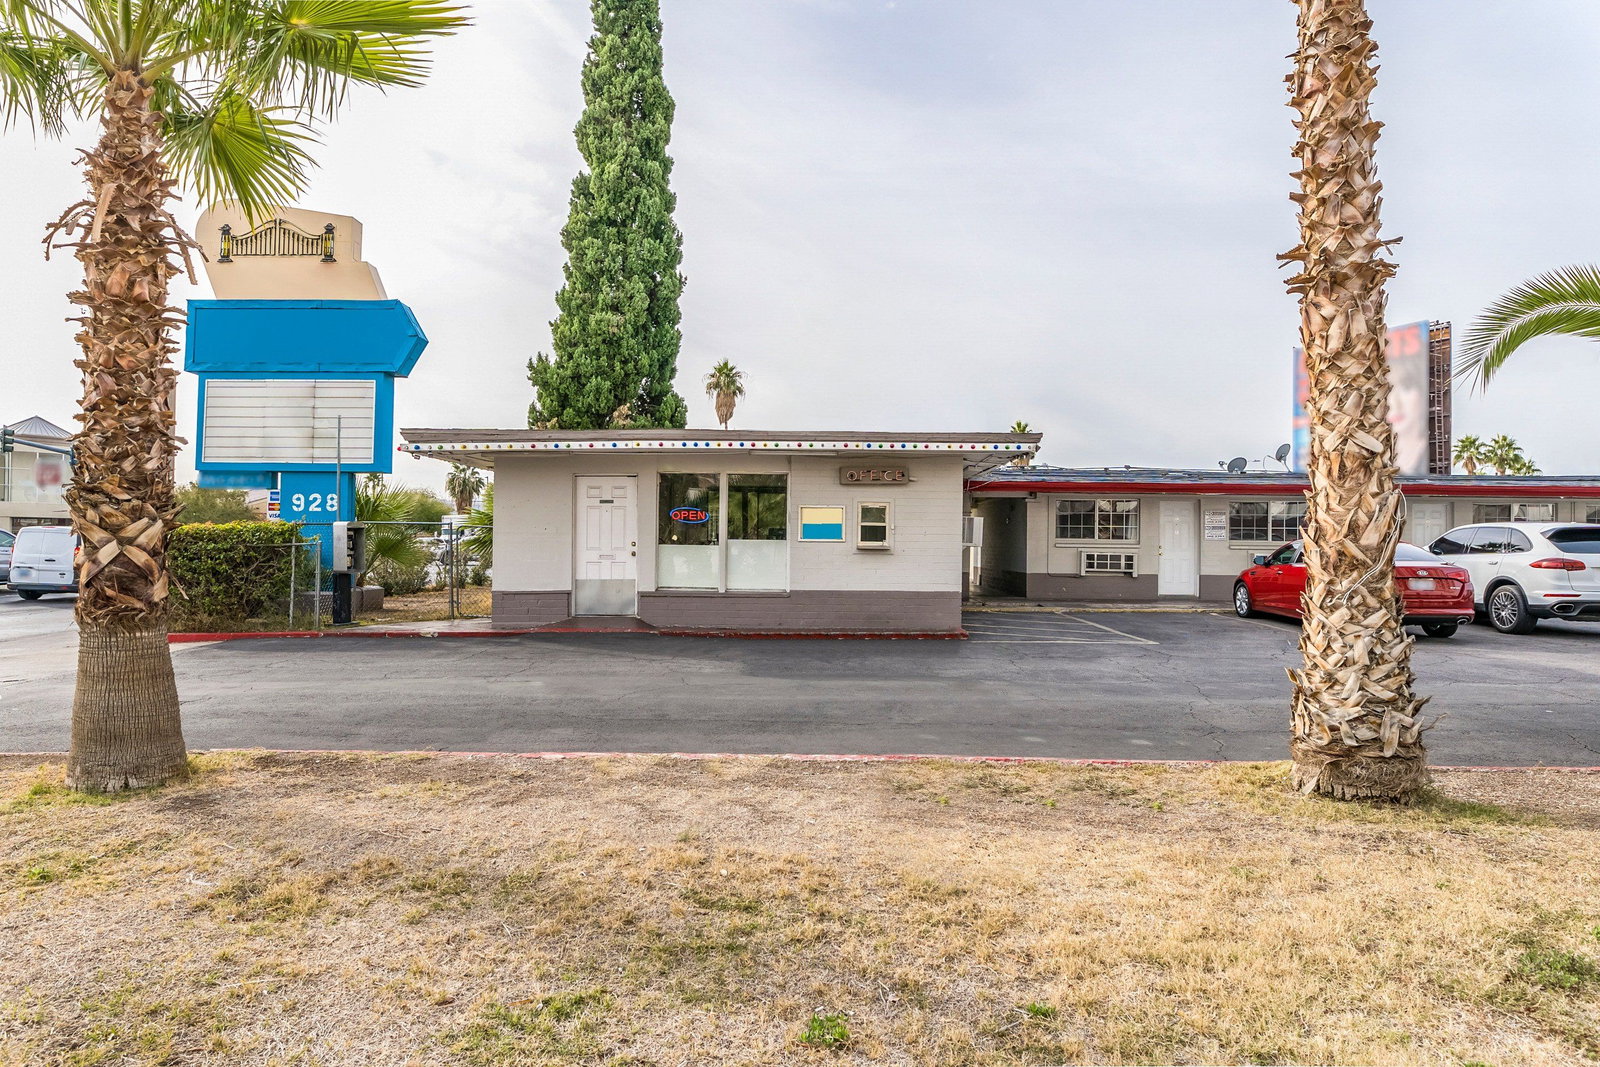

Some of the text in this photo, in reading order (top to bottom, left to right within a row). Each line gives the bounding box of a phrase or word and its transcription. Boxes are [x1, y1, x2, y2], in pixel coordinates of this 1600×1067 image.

[847, 470, 904, 481] OFFICE
[292, 493, 338, 511] 928
[671, 510, 706, 520] OPEN
